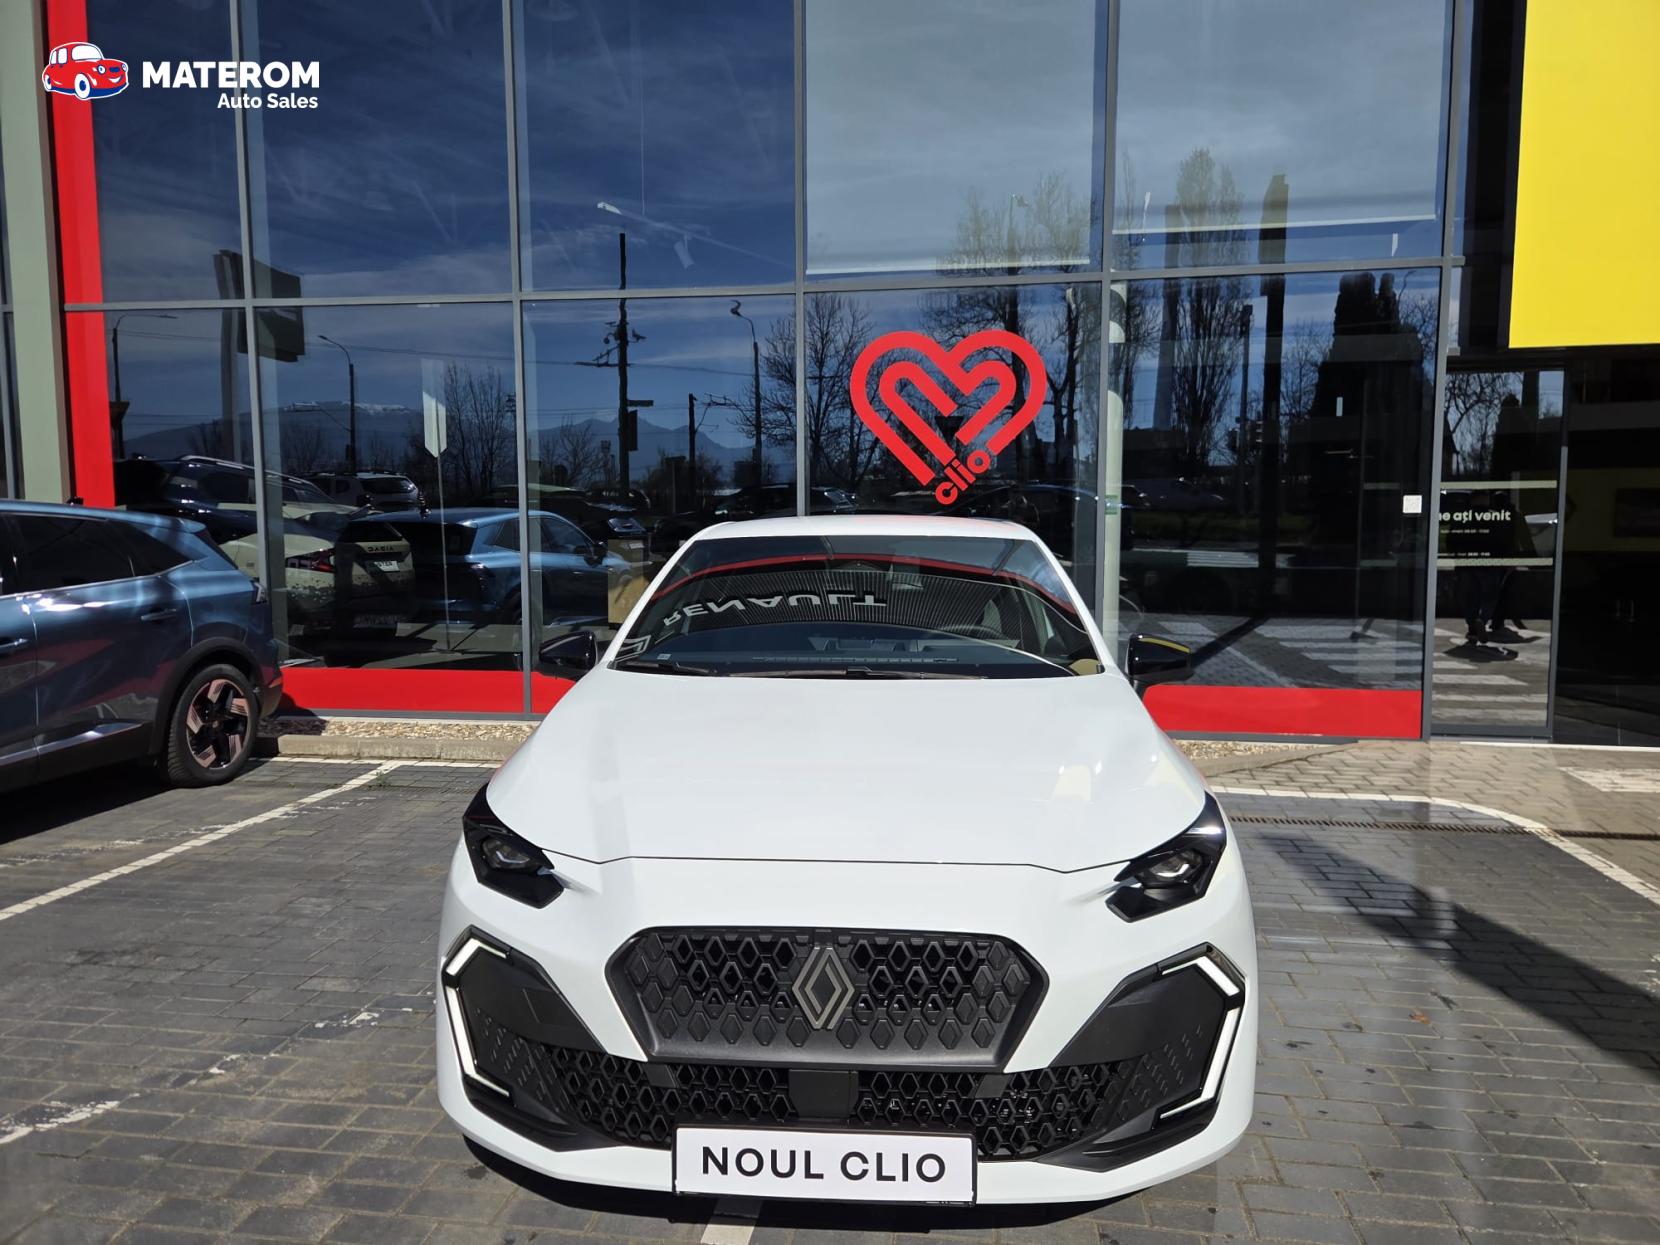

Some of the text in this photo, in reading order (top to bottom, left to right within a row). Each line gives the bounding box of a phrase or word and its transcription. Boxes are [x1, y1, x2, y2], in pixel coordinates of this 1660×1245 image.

[935, 449, 991, 505] clio
[1474, 509, 1512, 521] venit
[701, 1146, 947, 1183] NOUL CLIO
